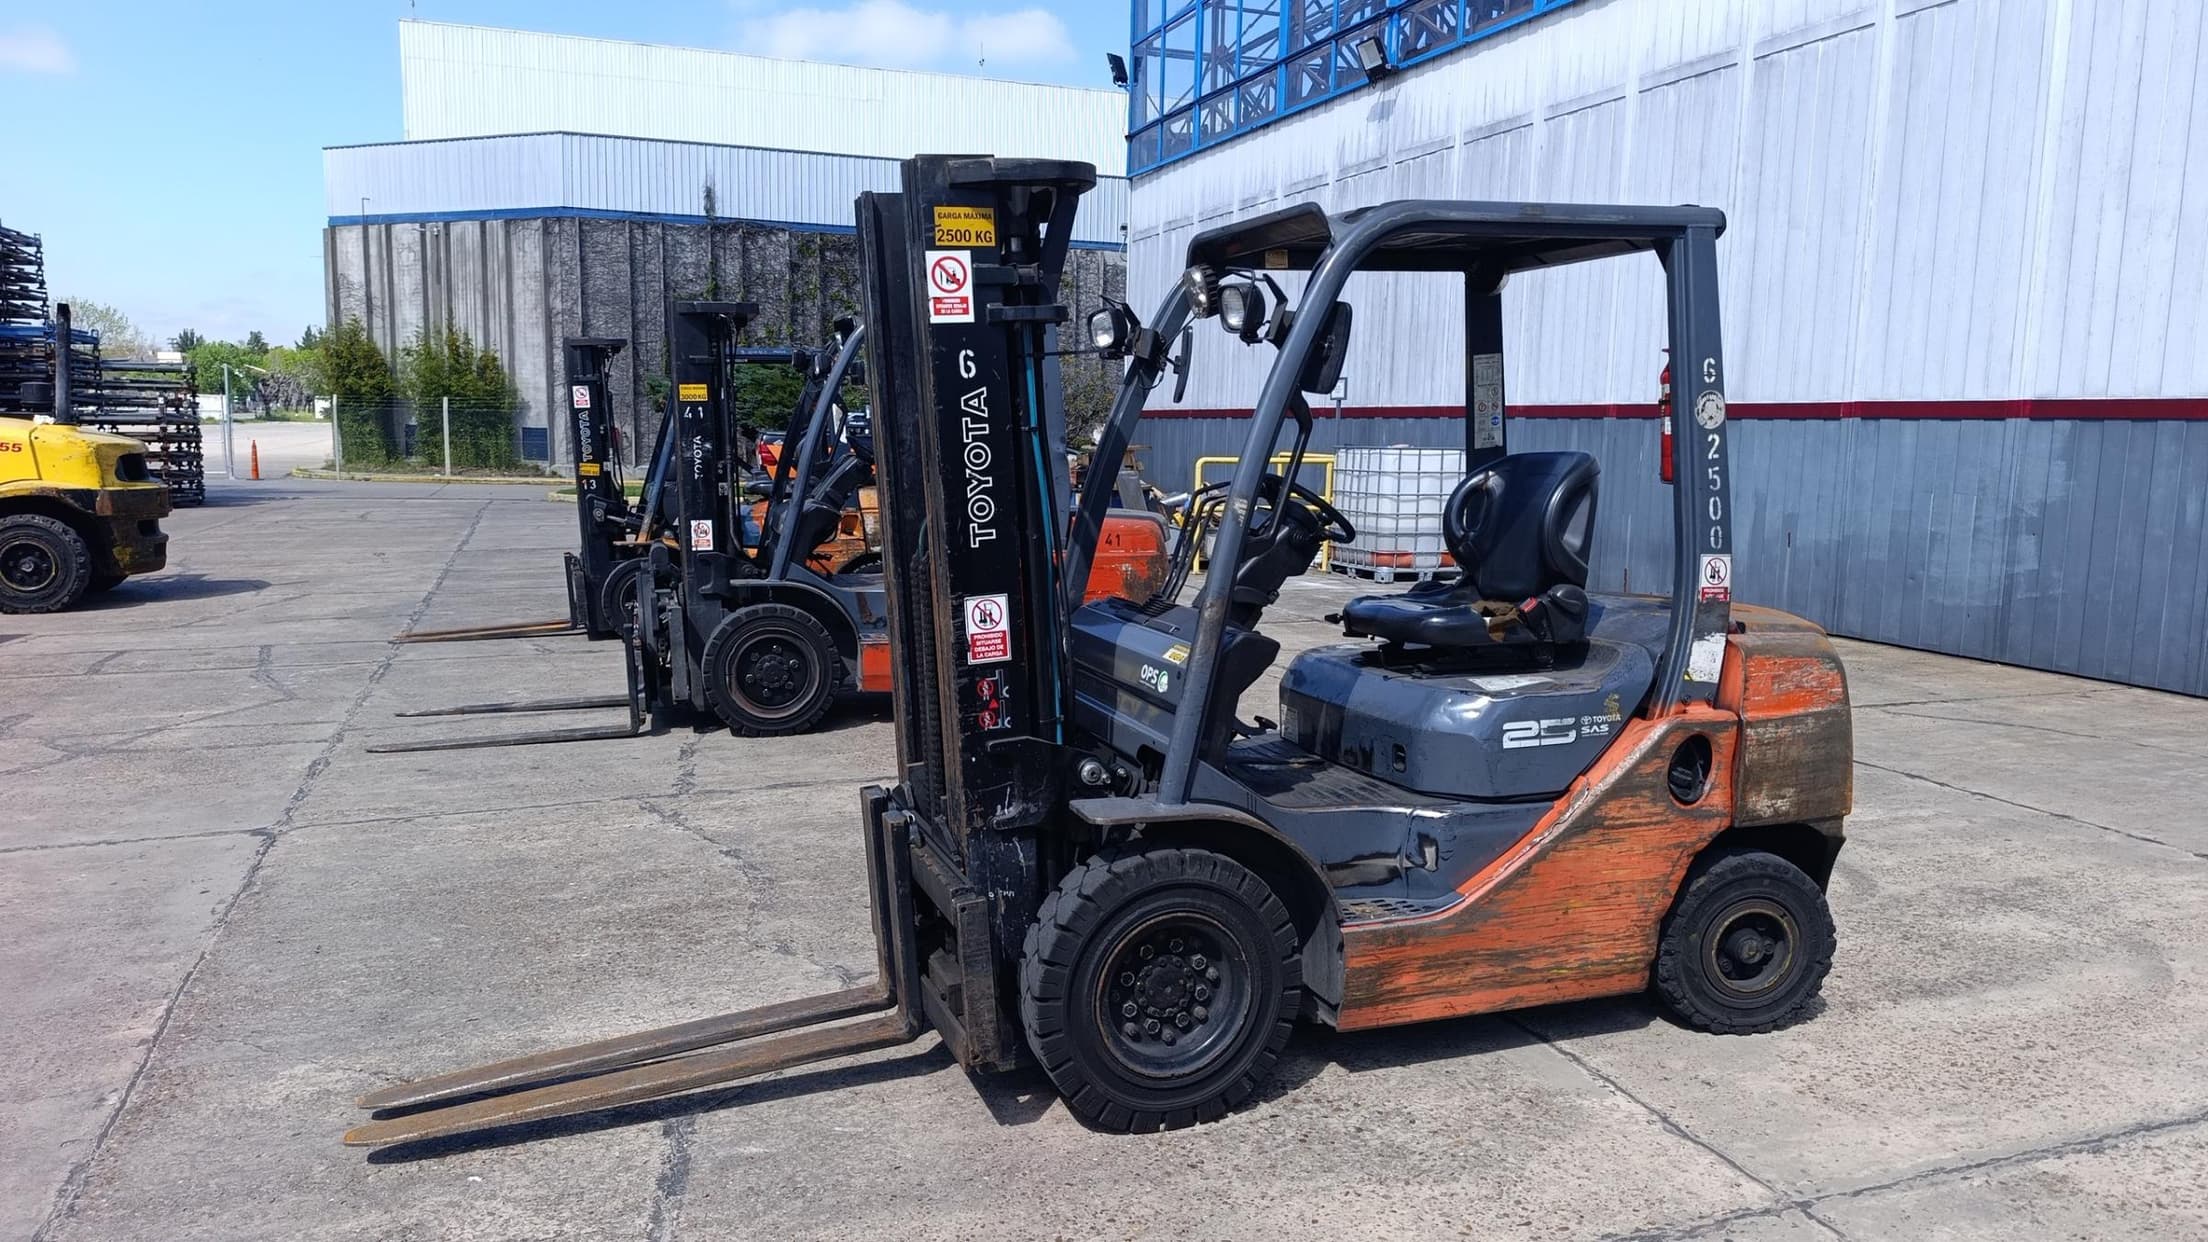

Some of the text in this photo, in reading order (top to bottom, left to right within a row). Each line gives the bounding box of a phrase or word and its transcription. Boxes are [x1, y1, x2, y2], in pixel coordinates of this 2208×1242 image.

[937, 229, 993, 243] 2500 KG
[959, 349, 976, 379] 6
[1703, 357, 1716, 383] 6
[683, 406, 704, 419] 41
[579, 411, 593, 462] TOYOTA
[693, 435, 703, 480] TOYOTA
[960, 386, 997, 548] TOYOTA
[581, 480, 597, 490] 13
[1105, 533, 1121, 547] 41
[1140, 664, 1159, 684] OPS
[1592, 714, 1621, 723] TOYOTA
[1503, 717, 1577, 749] 25
[1581, 724, 1609, 734] SAS
